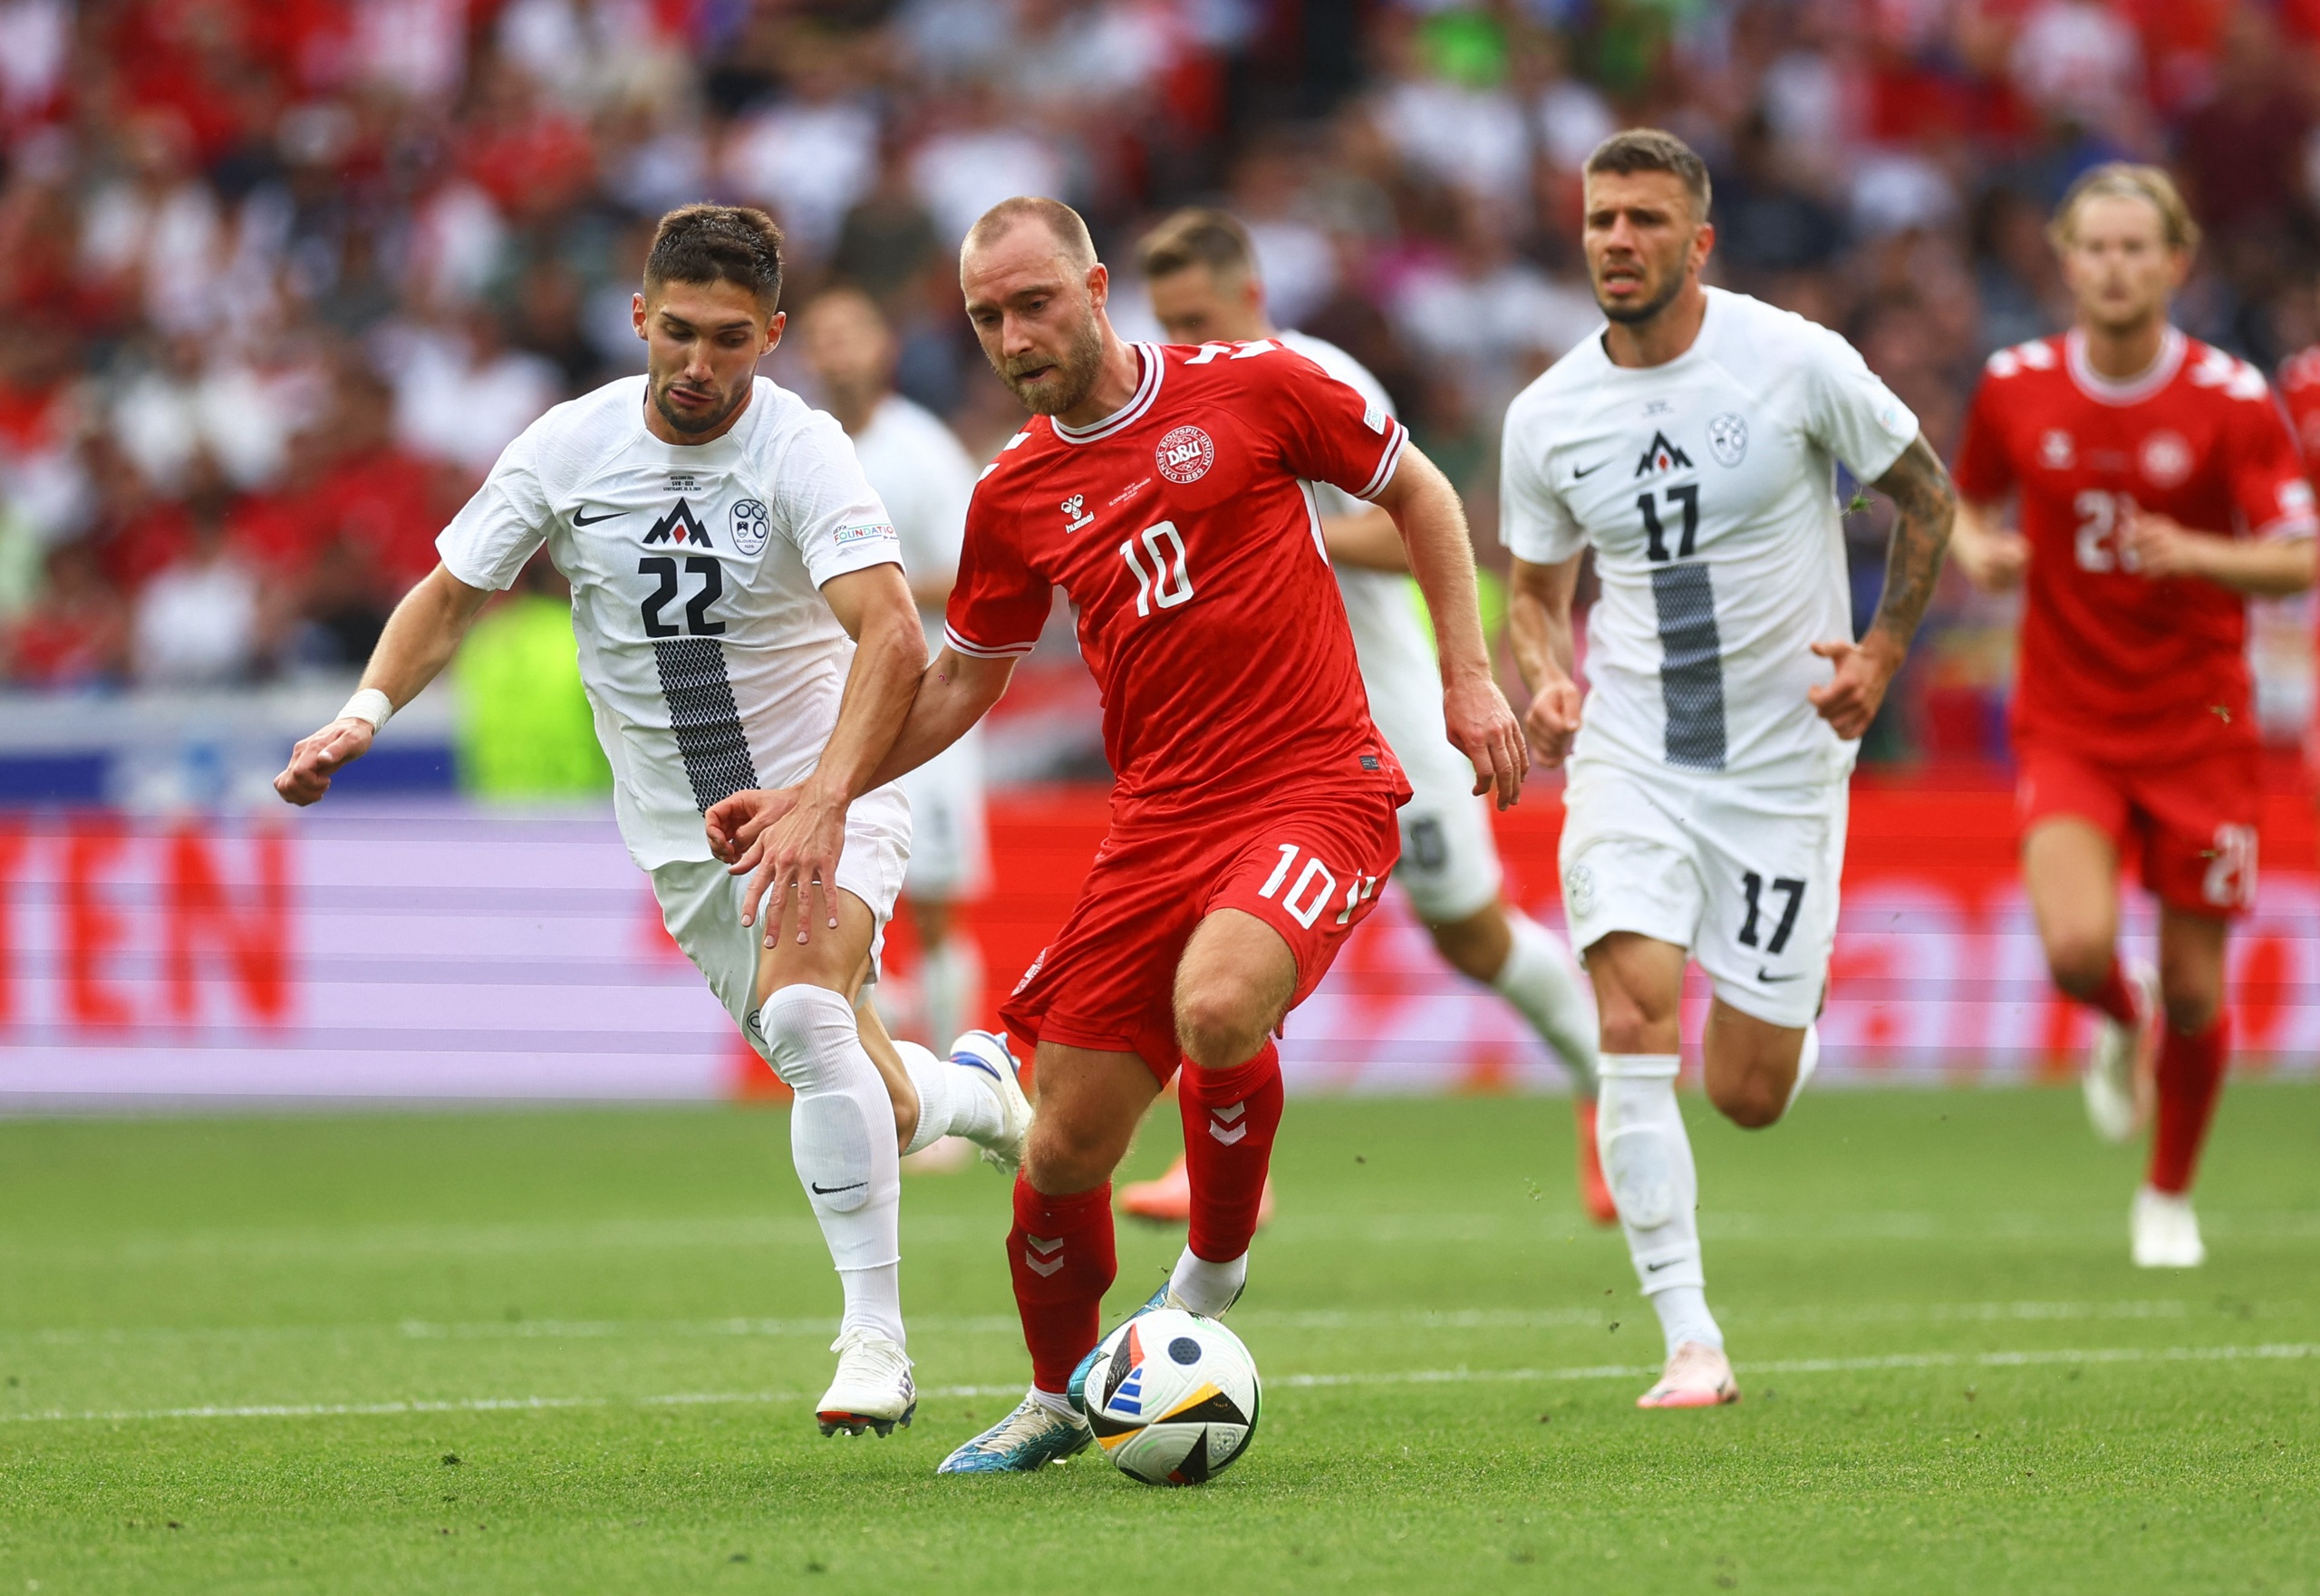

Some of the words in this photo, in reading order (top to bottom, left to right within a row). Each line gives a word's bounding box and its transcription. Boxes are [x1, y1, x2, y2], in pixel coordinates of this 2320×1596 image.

[1157, 450, 1178, 480] DANSK
[1165, 440, 1203, 467] DBU
[1181, 468, 1204, 481] 1889
[1200, 435, 1212, 466] UNION
[1065, 510, 1095, 534] hummel
[1637, 483, 1698, 561] 17
[1119, 520, 1194, 618] 10
[638, 556, 725, 638] 22
[1258, 843, 1337, 931] 10
[1738, 871, 1806, 954] 17
